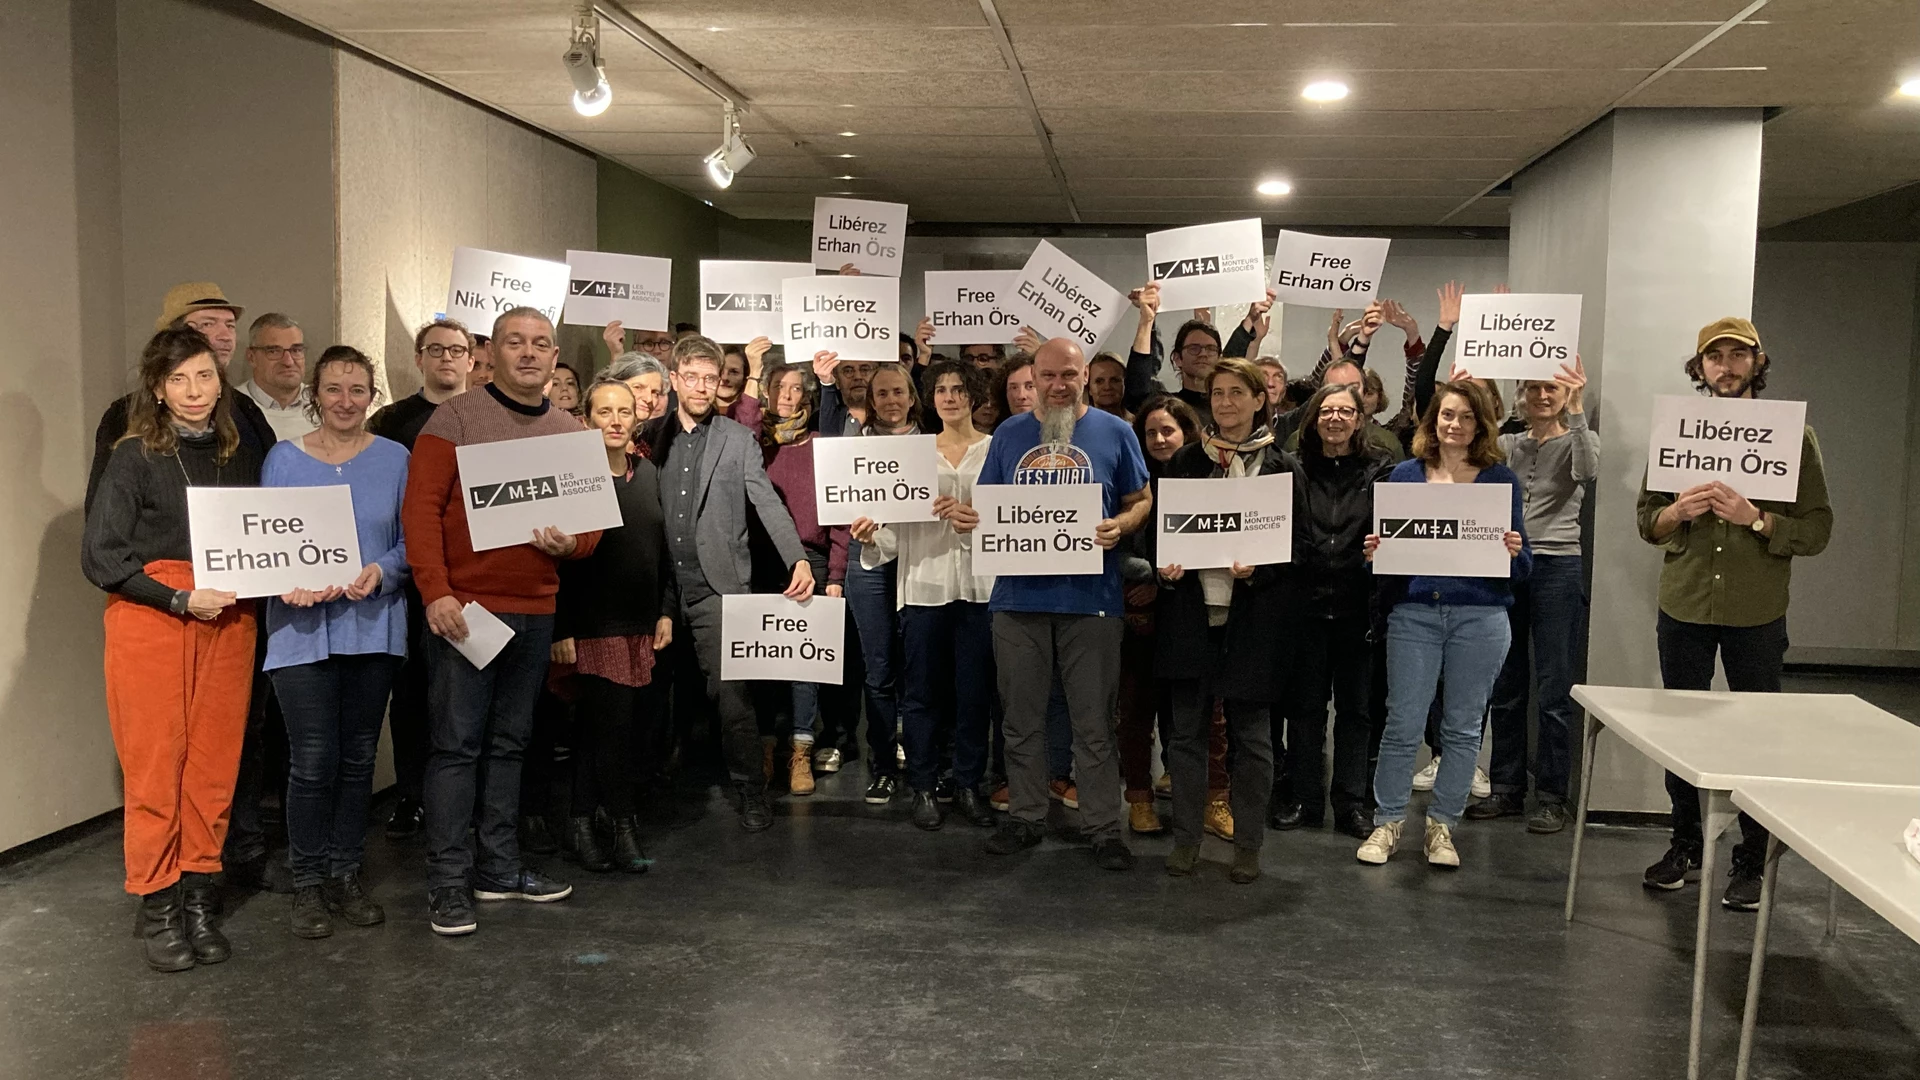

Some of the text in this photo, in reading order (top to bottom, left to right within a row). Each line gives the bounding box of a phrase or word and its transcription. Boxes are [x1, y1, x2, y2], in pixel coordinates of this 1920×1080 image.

[829, 213, 887, 235] Libérez
[817, 236, 896, 259] Erhan Örs
[1221, 258, 1259, 268] MONTEURS
[1222, 264, 1255, 274] ASSOCIÉS
[1309, 252, 1351, 270] Free
[490, 271, 532, 293] Free
[1041, 266, 1103, 318] Libérez
[1278, 271, 1372, 293] Erhan Örs
[455, 289, 486, 310] Nik
[631, 295, 661, 303] ASSOCIÉS
[632, 289, 665, 298] MONTEURS
[957, 287, 995, 304] Free
[803, 295, 876, 314] Libérez
[1016, 280, 1098, 346] Erhan Örs
[933, 307, 1020, 327] Erhan Örs
[1480, 313, 1556, 332] Libérez
[791, 319, 891, 341] Erhan Örs
[1463, 336, 1568, 360] Erhan Örs
[1679, 419, 1773, 444] Libérez
[853, 456, 900, 475] Free
[1658, 447, 1788, 477] Erhan Örs
[559, 473, 574, 481] LES
[560, 476, 607, 489] MONTEURS
[562, 483, 603, 497] ASSOCIÉS
[825, 478, 930, 503] Erhan Örs
[996, 504, 1078, 524] Libérez
[1244, 515, 1286, 525] MONTEURS
[242, 513, 305, 536] Free
[1244, 522, 1281, 532] ASSOCIÉS
[1461, 526, 1505, 534] MONTEURS
[981, 528, 1094, 553] Erhan Örs
[1461, 532, 1500, 541] ASSOCIÉS
[205, 539, 349, 572] Erhan Örs
[761, 613, 808, 632] Free
[730, 637, 836, 662] Erhan Örs
